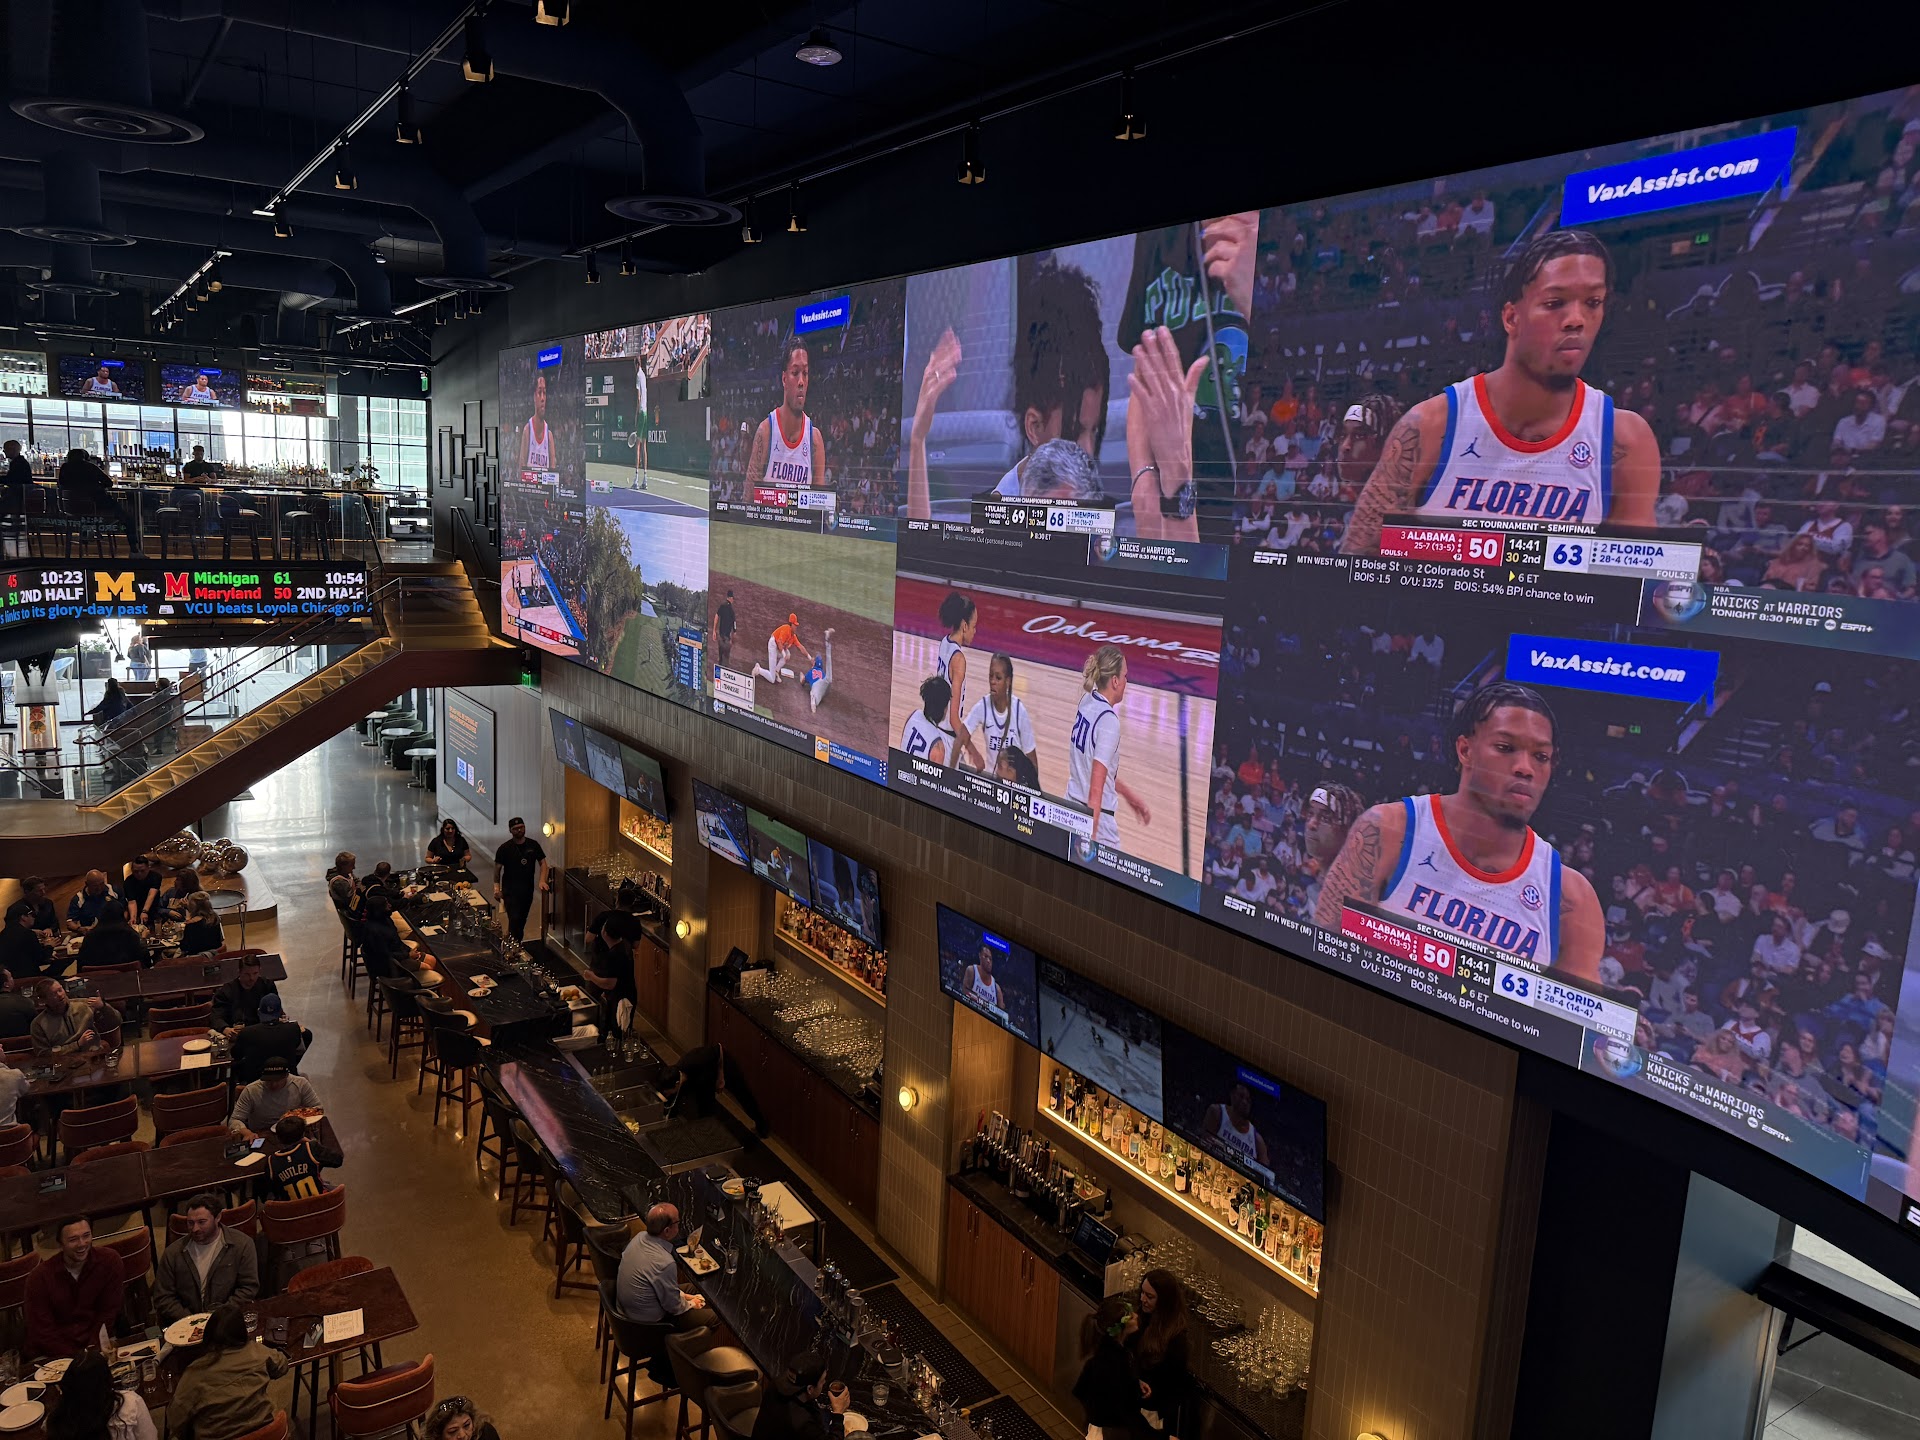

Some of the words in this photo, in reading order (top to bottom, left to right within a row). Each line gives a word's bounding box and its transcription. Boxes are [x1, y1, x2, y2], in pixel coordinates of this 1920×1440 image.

[1587, 158, 1759, 204] VaxAssist.com
[801, 308, 842, 324] VaxAssist.com
[648, 430, 667, 443] ROLEX
[772, 461, 808, 484] FLORIDA
[778, 492, 786, 504] 50
[800, 494, 808, 505] 63
[1445, 477, 1591, 523] FLORIDA
[1012, 509, 1025, 524] 69
[1032, 509, 1043, 518] 1:19
[1050, 513, 1064, 526] 68
[1074, 511, 1100, 519] MEMPHIS
[908, 521, 929, 531] ESPN2
[1462, 519, 1478, 528] SEC
[1479, 520, 1539, 531] TOURNAMENT
[1547, 524, 1596, 535] SEMIFINAL
[1401, 531, 1406, 539] 3
[1407, 531, 1456, 543] ALABAMA
[1509, 539, 1540, 551] 14:41
[1146, 546, 1176, 555] WARRIORS
[1380, 549, 1403, 557] FOULS:
[1431, 543, 1456, 552] (13-5)
[1469, 538, 1498, 559] 50
[1553, 544, 1583, 565] 63
[1601, 544, 1607, 553] 2
[1609, 544, 1664, 557] FLORIDA
[1253, 551, 1288, 566] ESPN
[1297, 555, 1313, 564] MTN
[1314, 557, 1334, 566] WEST
[1334, 558, 1348, 568] (M)
[1362, 559, 1387, 571] Boise
[1389, 562, 1400, 572] St
[1403, 564, 1413, 573] vs
[1424, 565, 1470, 577] Colorado
[1473, 568, 1485, 579] St
[1506, 552, 1519, 563] 30
[1522, 554, 1541, 565] 2nd
[1599, 555, 1622, 564] 28-4
[1623, 556, 1654, 567] (14-4)
[8, 574, 17, 588] 45
[41, 571, 83, 585] 10:23
[194, 572, 259, 587] Michigan
[274, 572, 291, 584] 61
[325, 572, 364, 584] 10:54
[1526, 574, 1539, 583] ET
[1656, 570, 1688, 579] FOULS:
[94, 572, 136, 601] M
[138, 583, 160, 593] vs.
[164, 572, 191, 601] M
[195, 587, 261, 602] Maryland
[274, 587, 292, 599] 50
[297, 588, 326, 599] 2ND
[330, 588, 364, 600] HALF
[1354, 572, 1375, 582] BOIS
[1400, 576, 1420, 587] O/U:
[1422, 578, 1444, 588] 137.5
[1454, 581, 1480, 593] BOIS:
[1482, 583, 1504, 595] 54%
[1506, 585, 1523, 597] BPI
[1525, 587, 1561, 601] chance
[1563, 590, 1574, 602] to
[1576, 592, 1594, 604] win
[9, 592, 19, 606] 51
[20, 589, 42, 603] 2ND
[45, 588, 84, 600] HALF
[4, 609, 21, 622] links
[21, 609, 30, 619] to
[31, 605, 46, 618] its
[48, 603, 113, 619] glory-day
[117, 603, 149, 618] past
[185, 603, 213, 614] VCU
[217, 602, 253, 614] beats
[257, 602, 298, 616] Loyola
[301, 603, 350, 616] Chicago
[1712, 595, 1759, 610] KNICKS
[1764, 603, 1775, 612] AT
[1777, 602, 1843, 619] WARRIORS
[1711, 608, 1757, 621] TONIGHT
[1759, 613, 1783, 623] 8:30
[1785, 616, 1803, 625] PM
[1806, 618, 1819, 627] ET
[1840, 622, 1873, 633] ESPN+
[1022, 615, 1182, 650] Orleans
[1530, 650, 1686, 683] VaxAssist.com
[1071, 711, 1090, 754] 20
[912, 760, 943, 779] TIMEOUT
[997, 789, 1009, 804] 50
[1032, 802, 1046, 818] 54
[1123, 859, 1151, 876] WARRIORS
[1405, 883, 1540, 959] FLORIDA
[1366, 919, 1411, 943] ALABAMA
[1223, 895, 1256, 917] ESPN
[1264, 911, 1280, 923] MTN
[1280, 916, 1299, 930] WEST
[1300, 923, 1312, 936] (M)
[1325, 933, 1348, 950] Boise
[1350, 943, 1360, 954] St
[1363, 949, 1373, 959] vs
[1383, 955, 1425, 979] Colorado
[1427, 973, 1439, 985] St
[1389, 936, 1411, 951] (13-5)
[1417, 923, 1431, 934] SEC
[1433, 927, 1488, 954] TOURNAMENT
[1496, 951, 1541, 974] SEMIFINAL
[1423, 943, 1450, 968] 50
[1460, 955, 1490, 973] 14:41
[1457, 966, 1470, 978] 30
[1473, 972, 1490, 986] 2nd
[1318, 943, 1337, 958] BOIS
[1360, 960, 1380, 974] O/U:
[1381, 967, 1401, 983] 137.5
[1410, 979, 1435, 996] BOIS:
[1436, 988, 1457, 1005] 54%
[1458, 998, 1475, 1012] BPI
[1476, 1004, 1509, 1025] chance
[1511, 1016, 1521, 1030] to
[1522, 1021, 1540, 1038] win
[1501, 973, 1529, 998] 63
[1477, 993, 1489, 1004] ET
[1544, 994, 1564, 1007] 28-4
[1566, 1001, 1594, 1018] (14-4)
[1553, 986, 1603, 1012] FLORIDA
[1596, 1023, 1625, 1039] FOULS:
[1649, 1053, 1663, 1063] NBA
[1646, 1073, 1688, 1095] TONIGHT
[1689, 1091, 1711, 1106] 8:30
[1713, 1102, 1729, 1114] PM
[1730, 1108, 1743, 1119] ET
[1647, 1062, 1690, 1087] KNICKS
[1694, 1083, 1703, 1092] AT
[1706, 1086, 1764, 1119] WARRIORS
[278, 1163, 308, 1182] BUTLER
[283, 1175, 320, 1200] 10
